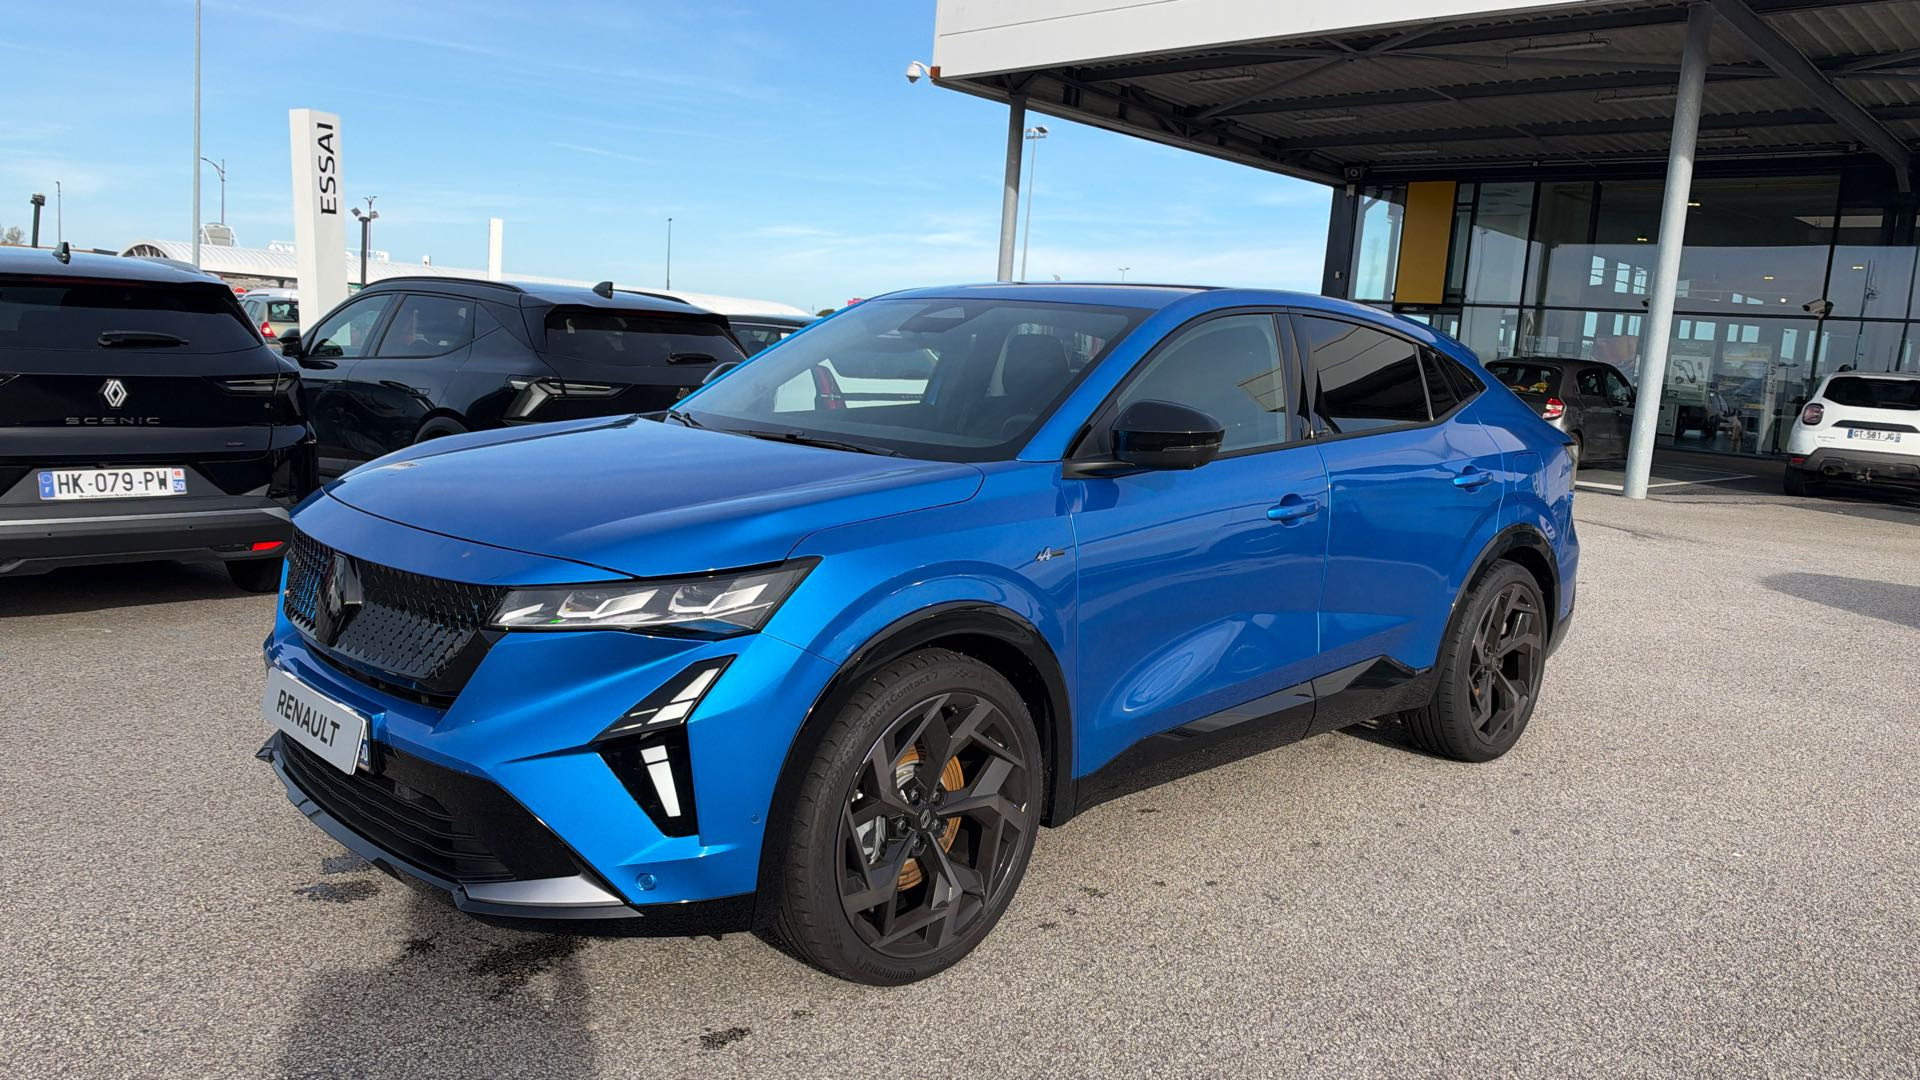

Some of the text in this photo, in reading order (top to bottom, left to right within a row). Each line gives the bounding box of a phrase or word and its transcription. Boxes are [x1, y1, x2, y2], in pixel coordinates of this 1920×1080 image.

[317, 122, 337, 215] ESSAI
[65, 417, 160, 425] SCENIC
[57, 470, 168, 494] HK-079-PW
[174, 481, 185, 490] 50
[276, 688, 341, 748] RENAULT
[862, 674, 931, 731] SportContact
